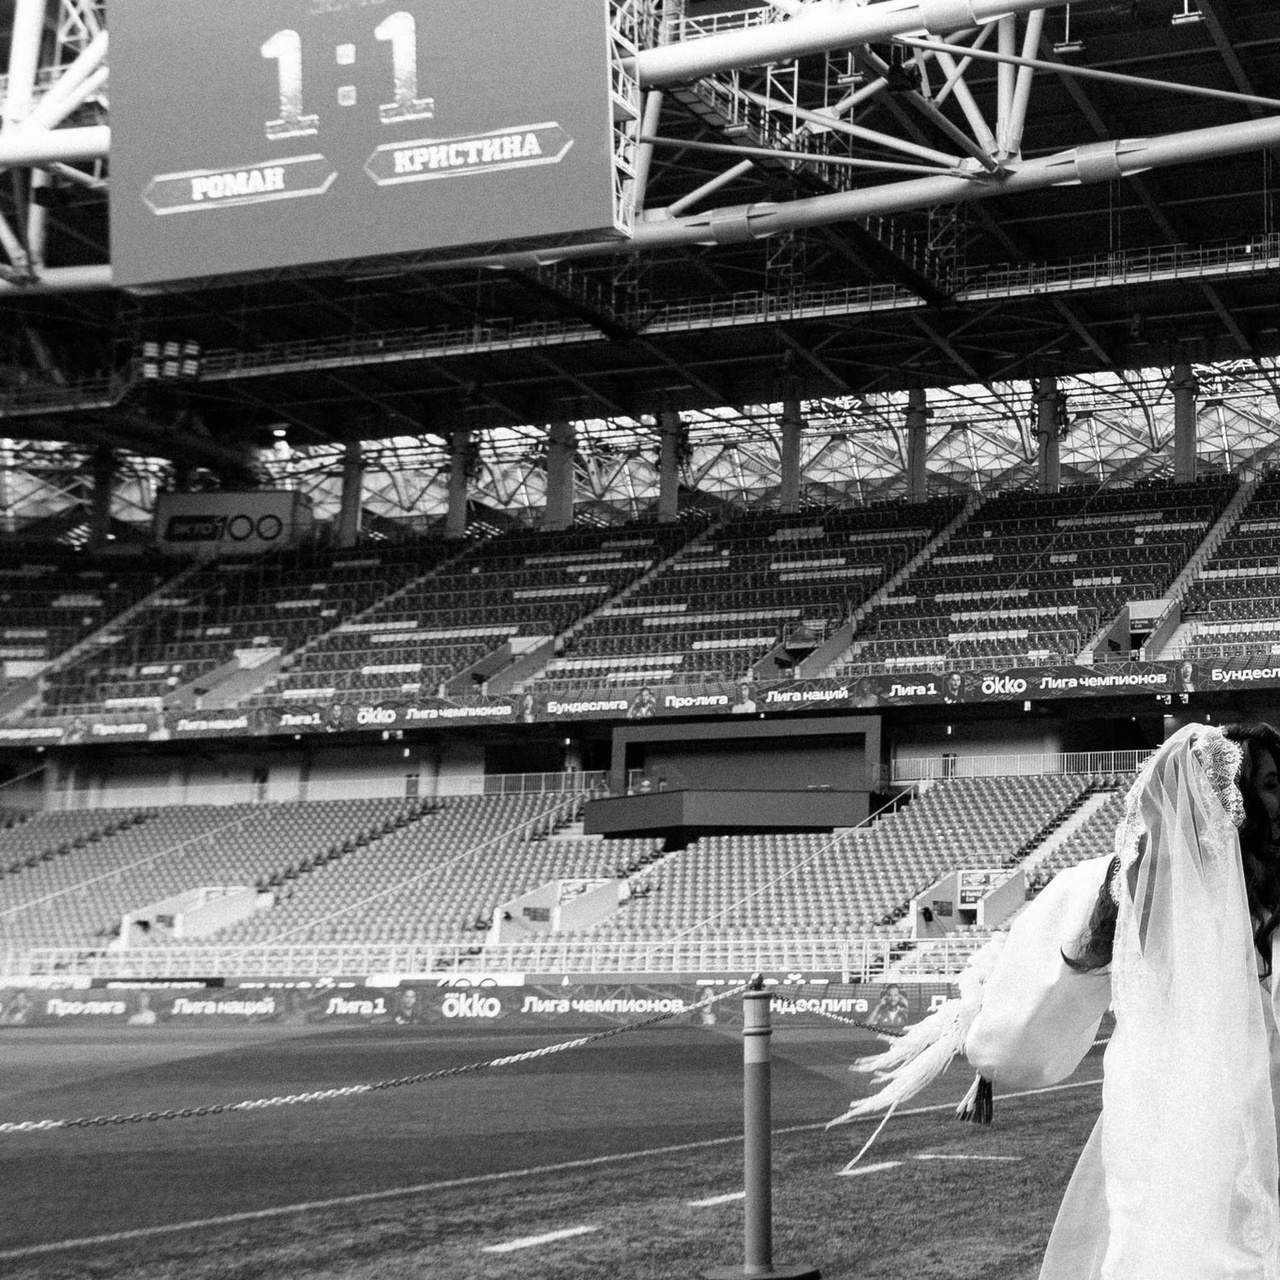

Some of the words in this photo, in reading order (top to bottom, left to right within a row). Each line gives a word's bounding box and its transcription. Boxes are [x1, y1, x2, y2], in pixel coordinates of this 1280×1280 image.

[394, 131, 544, 175] КРИСТИНА
[191, 166, 286, 202] РОМАН
[889, 685, 926, 697] Лига
[927, 683, 937, 695] 1
[1039, 676, 1078, 690] Лига
[1079, 672, 1168, 687] чемпионов
[765, 690, 802, 703] Лига
[802, 686, 849, 702] наций
[405, 708, 438, 720] Лига
[438, 705, 512, 719] чемпионов
[546, 698, 628, 714] Бундеслига
[325, 997, 374, 1015] Лига
[374, 997, 387, 1014] 1
[520, 996, 570, 1013] Лига
[571, 996, 685, 1014] чемпионов
